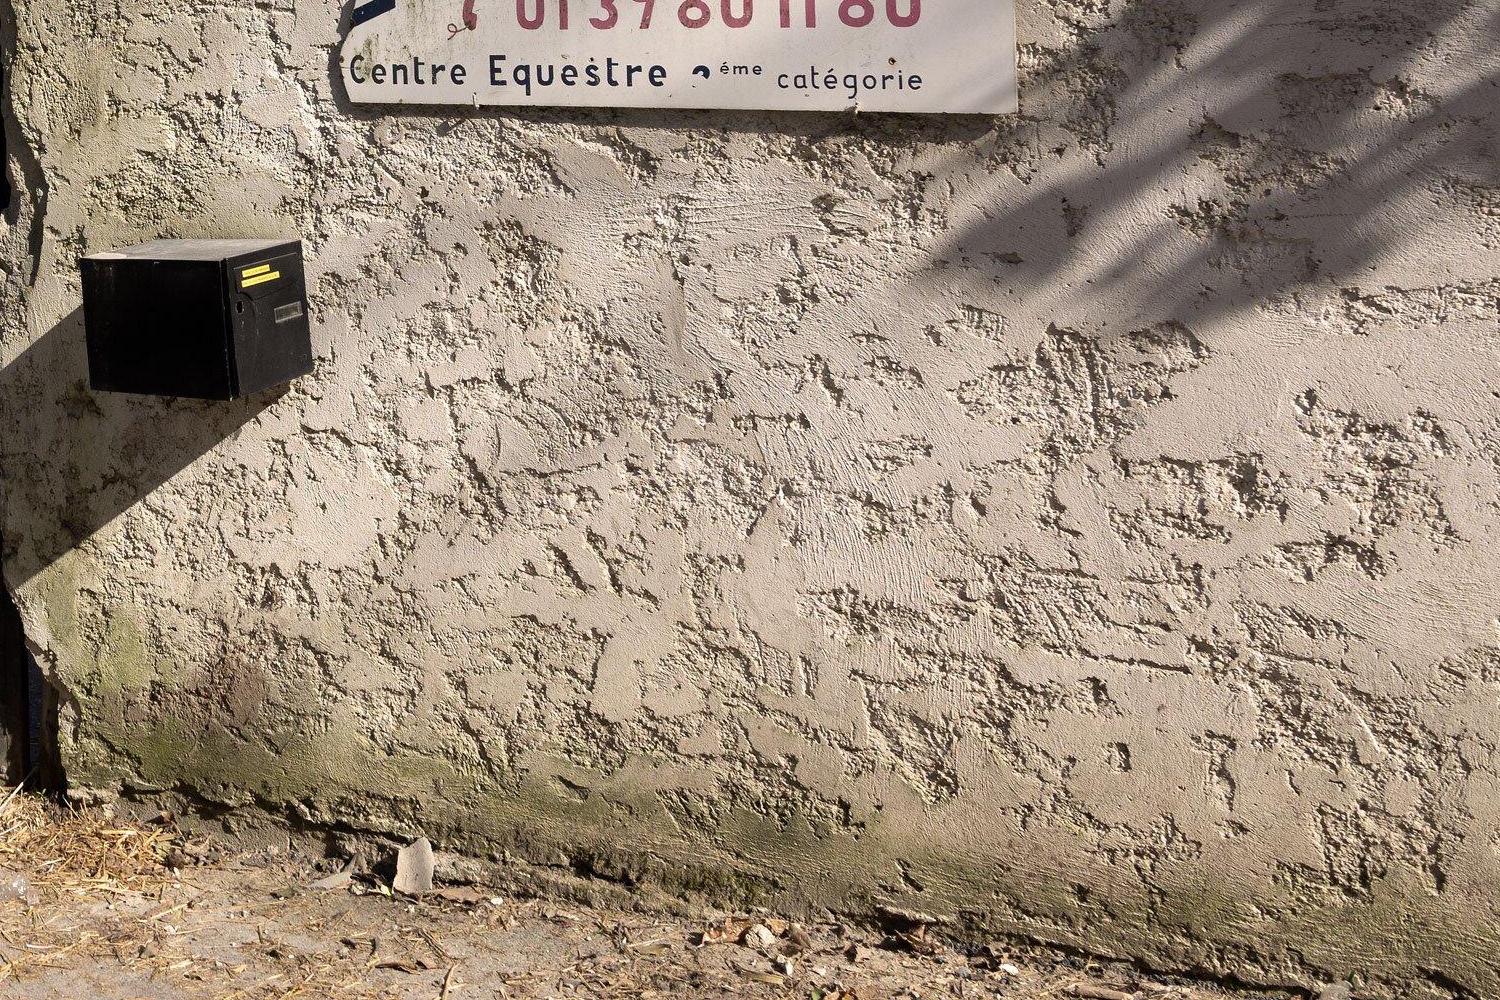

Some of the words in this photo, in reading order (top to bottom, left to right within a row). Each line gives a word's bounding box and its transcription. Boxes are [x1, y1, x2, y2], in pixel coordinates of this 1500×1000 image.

[350, 54, 467, 87] Centre
[489, 55, 669, 99] Equestre
[777, 65, 923, 100] catégorie
